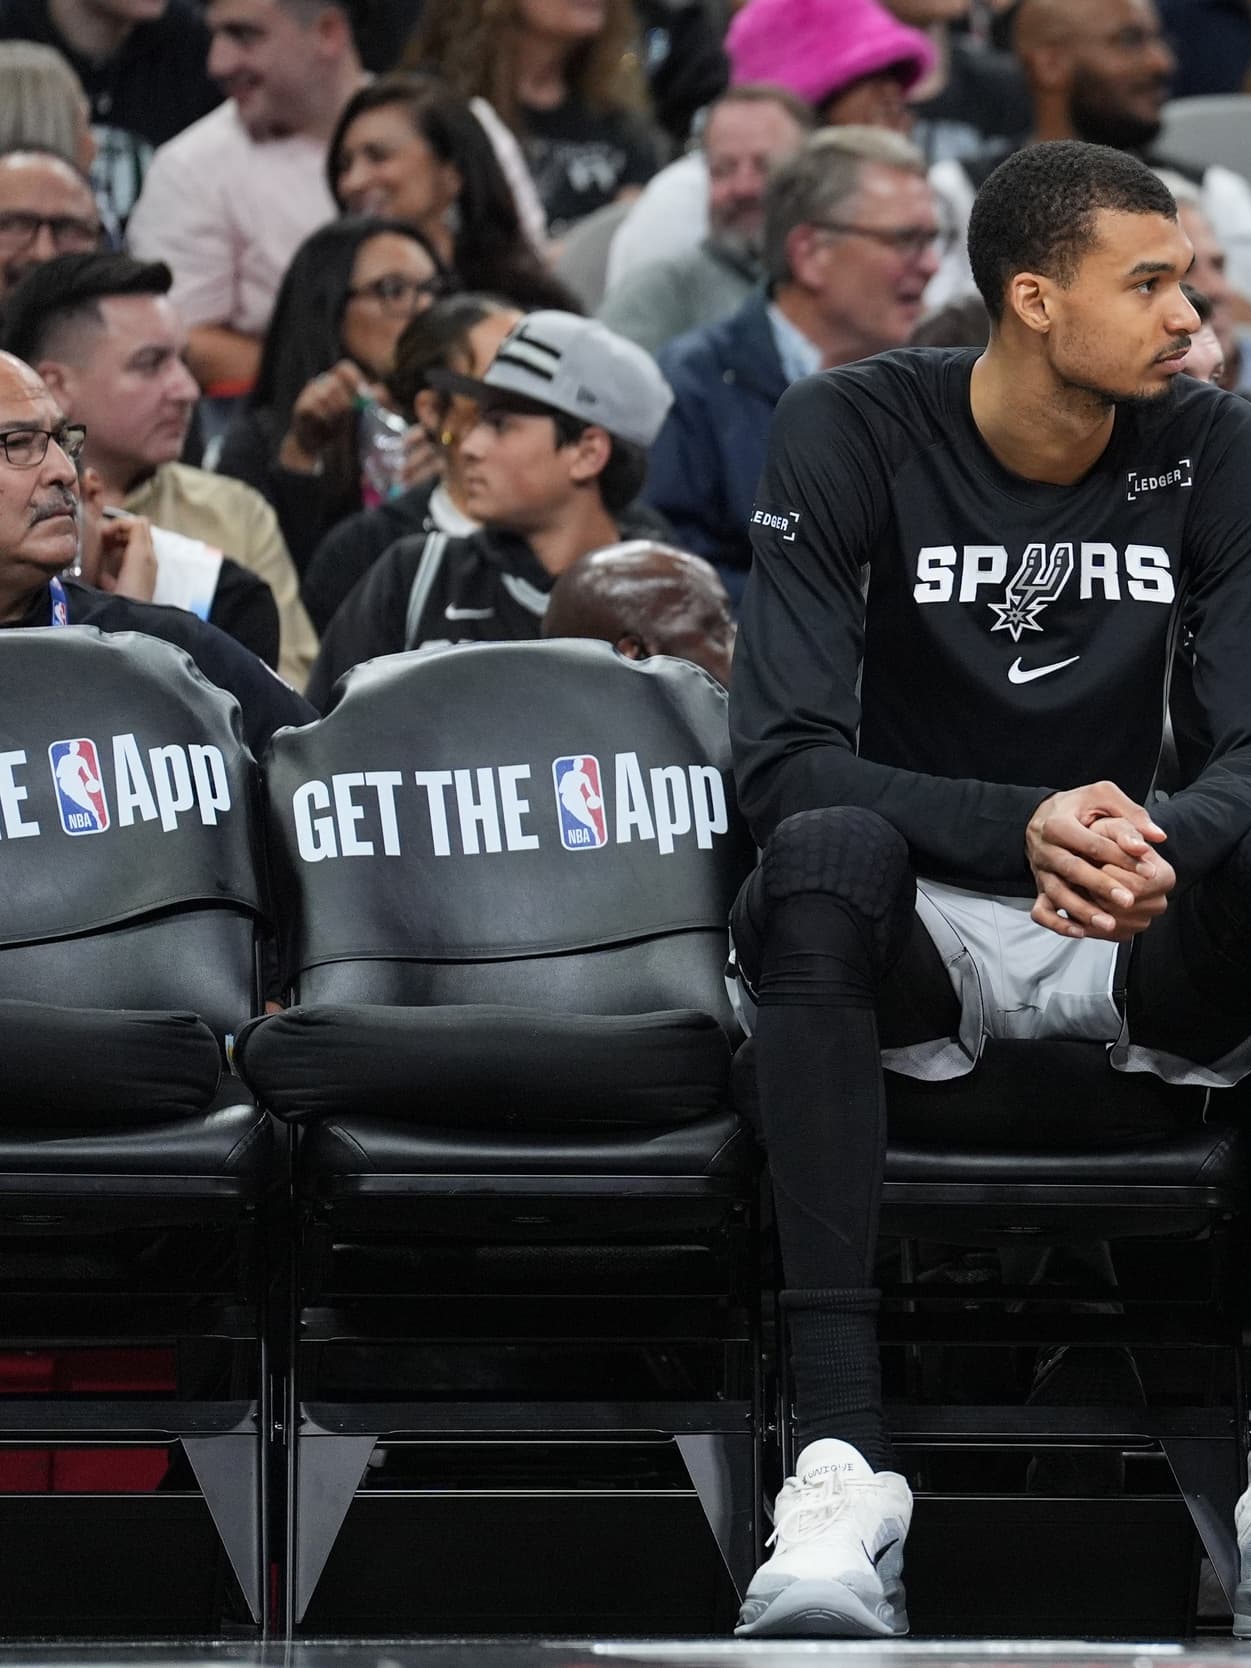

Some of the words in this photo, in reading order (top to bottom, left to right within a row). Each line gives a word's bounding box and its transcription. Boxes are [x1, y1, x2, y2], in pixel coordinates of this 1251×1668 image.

[1133, 468, 1182, 492] LEDGER
[750, 510, 789, 532] EDGER
[912, 542, 1176, 604] SPURS
[0, 750, 41, 840] E
[68, 811, 92, 830] NBA
[112, 733, 232, 833] App
[292, 771, 403, 863] GET
[415, 764, 540, 857] THE
[567, 828, 591, 845] NBA
[615, 752, 729, 855] App
